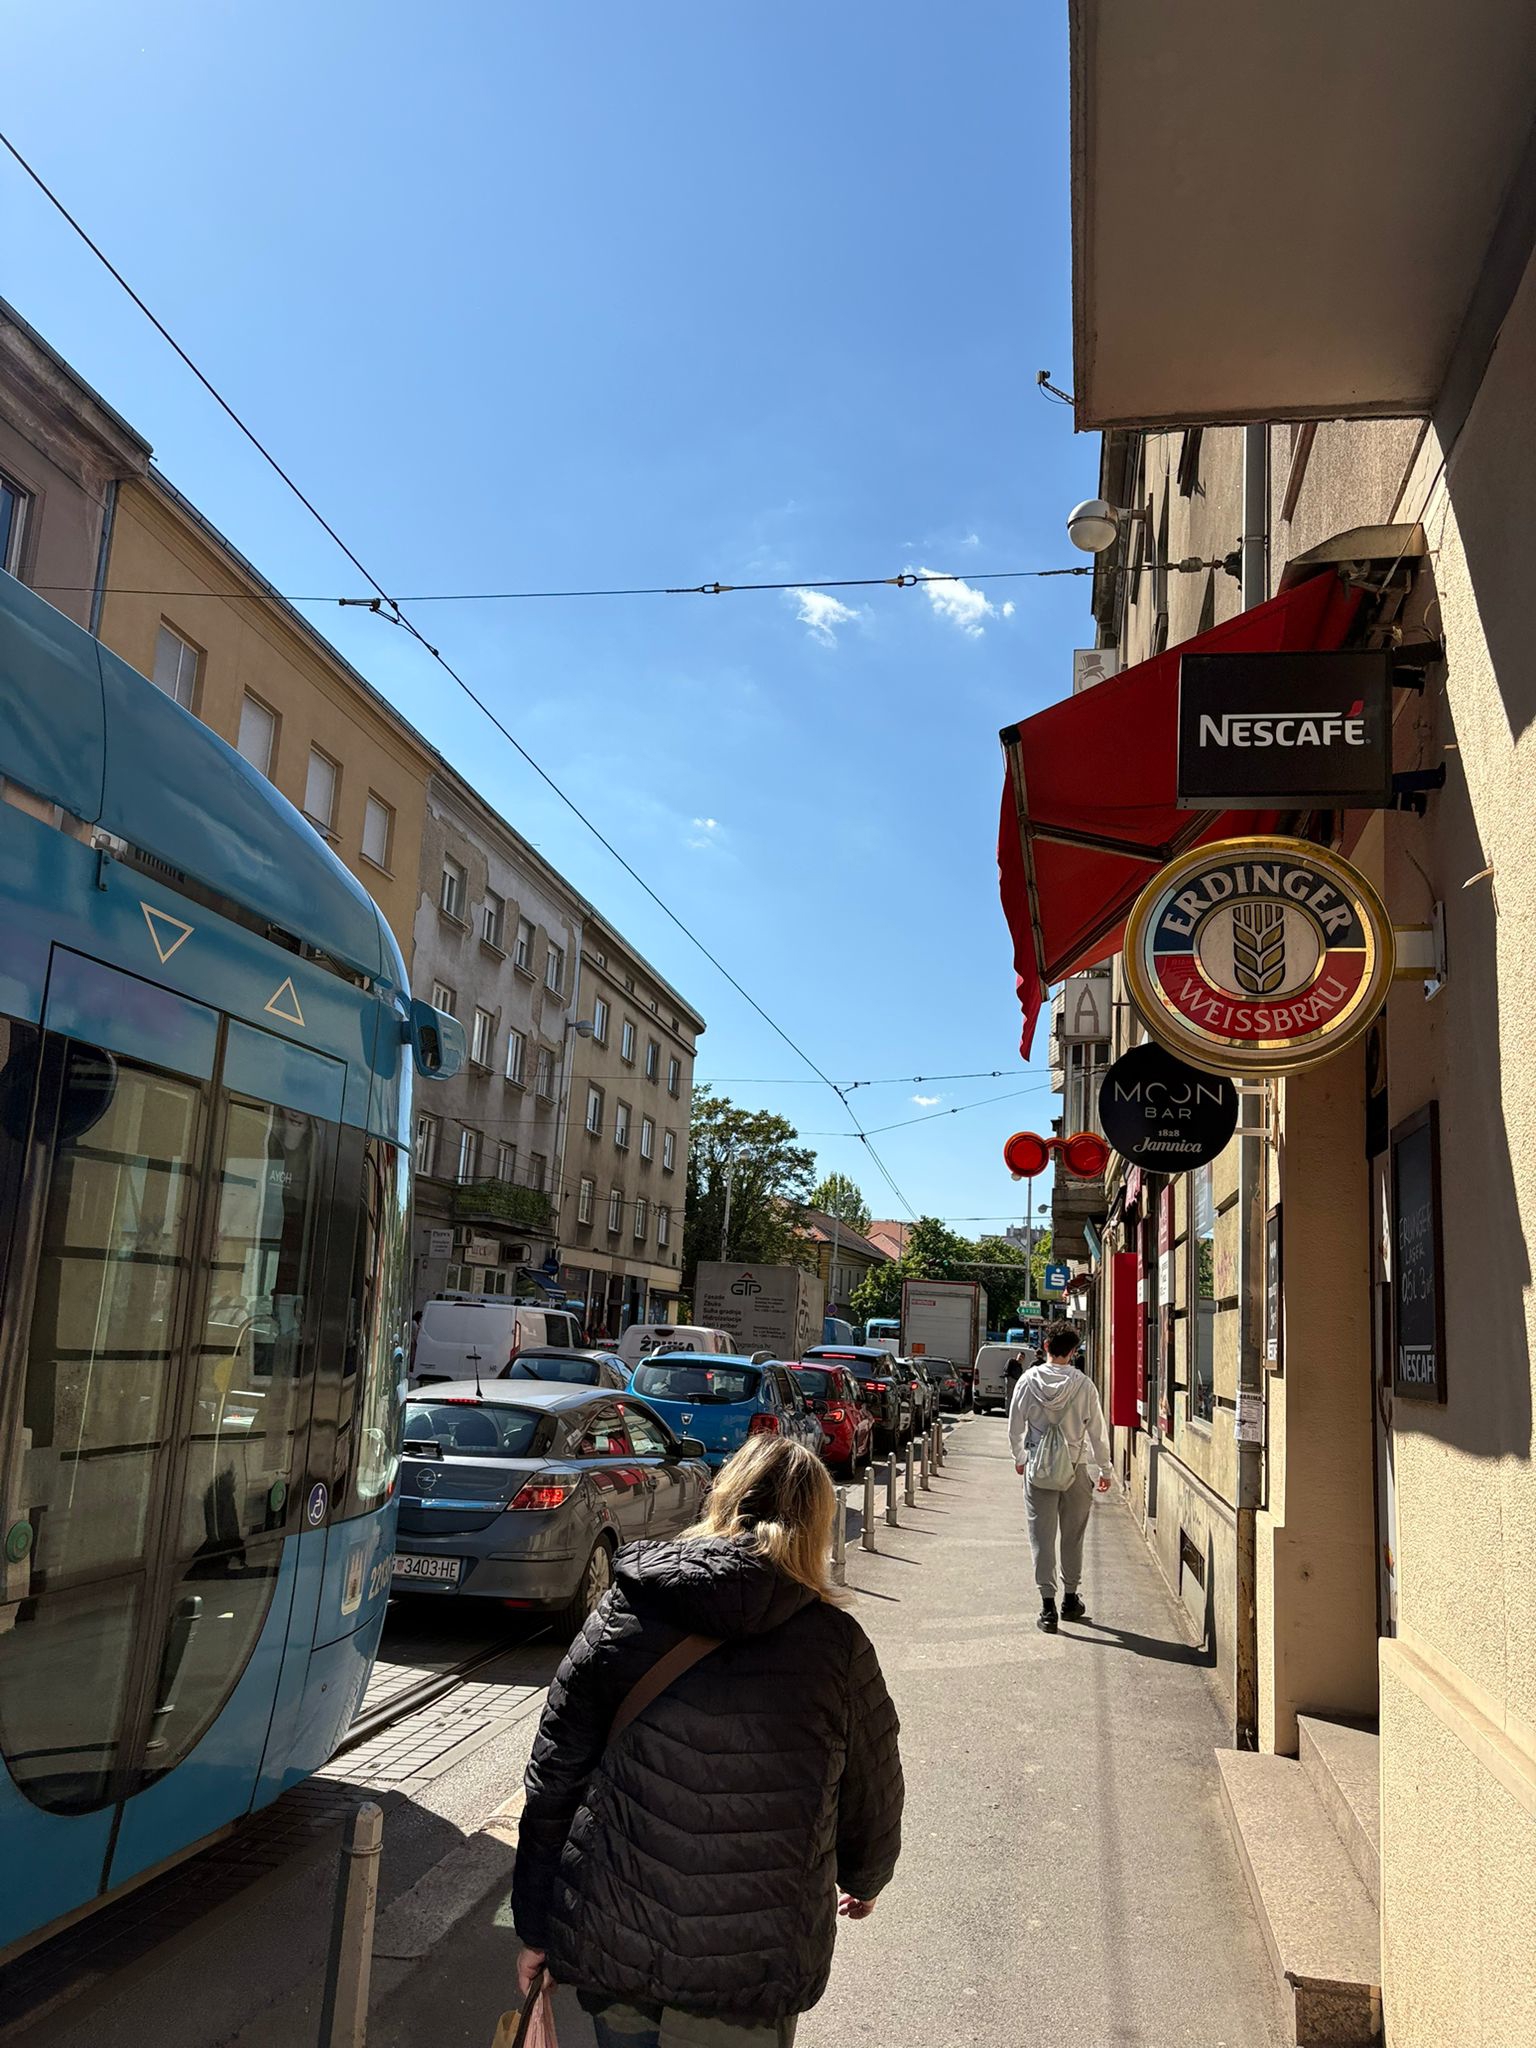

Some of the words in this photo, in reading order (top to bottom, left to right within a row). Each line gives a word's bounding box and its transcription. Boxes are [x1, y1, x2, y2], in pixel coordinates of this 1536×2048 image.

[1162, 865, 1353, 937] ERDINGER
[1180, 976, 1348, 1033] WEISSBRÄU
[1114, 1081, 1222, 1105] MOON
[1144, 1107, 1192, 1119] BAR
[1158, 1129, 1180, 1137] 1828
[1132, 1137, 1202, 1153] Jamnica
